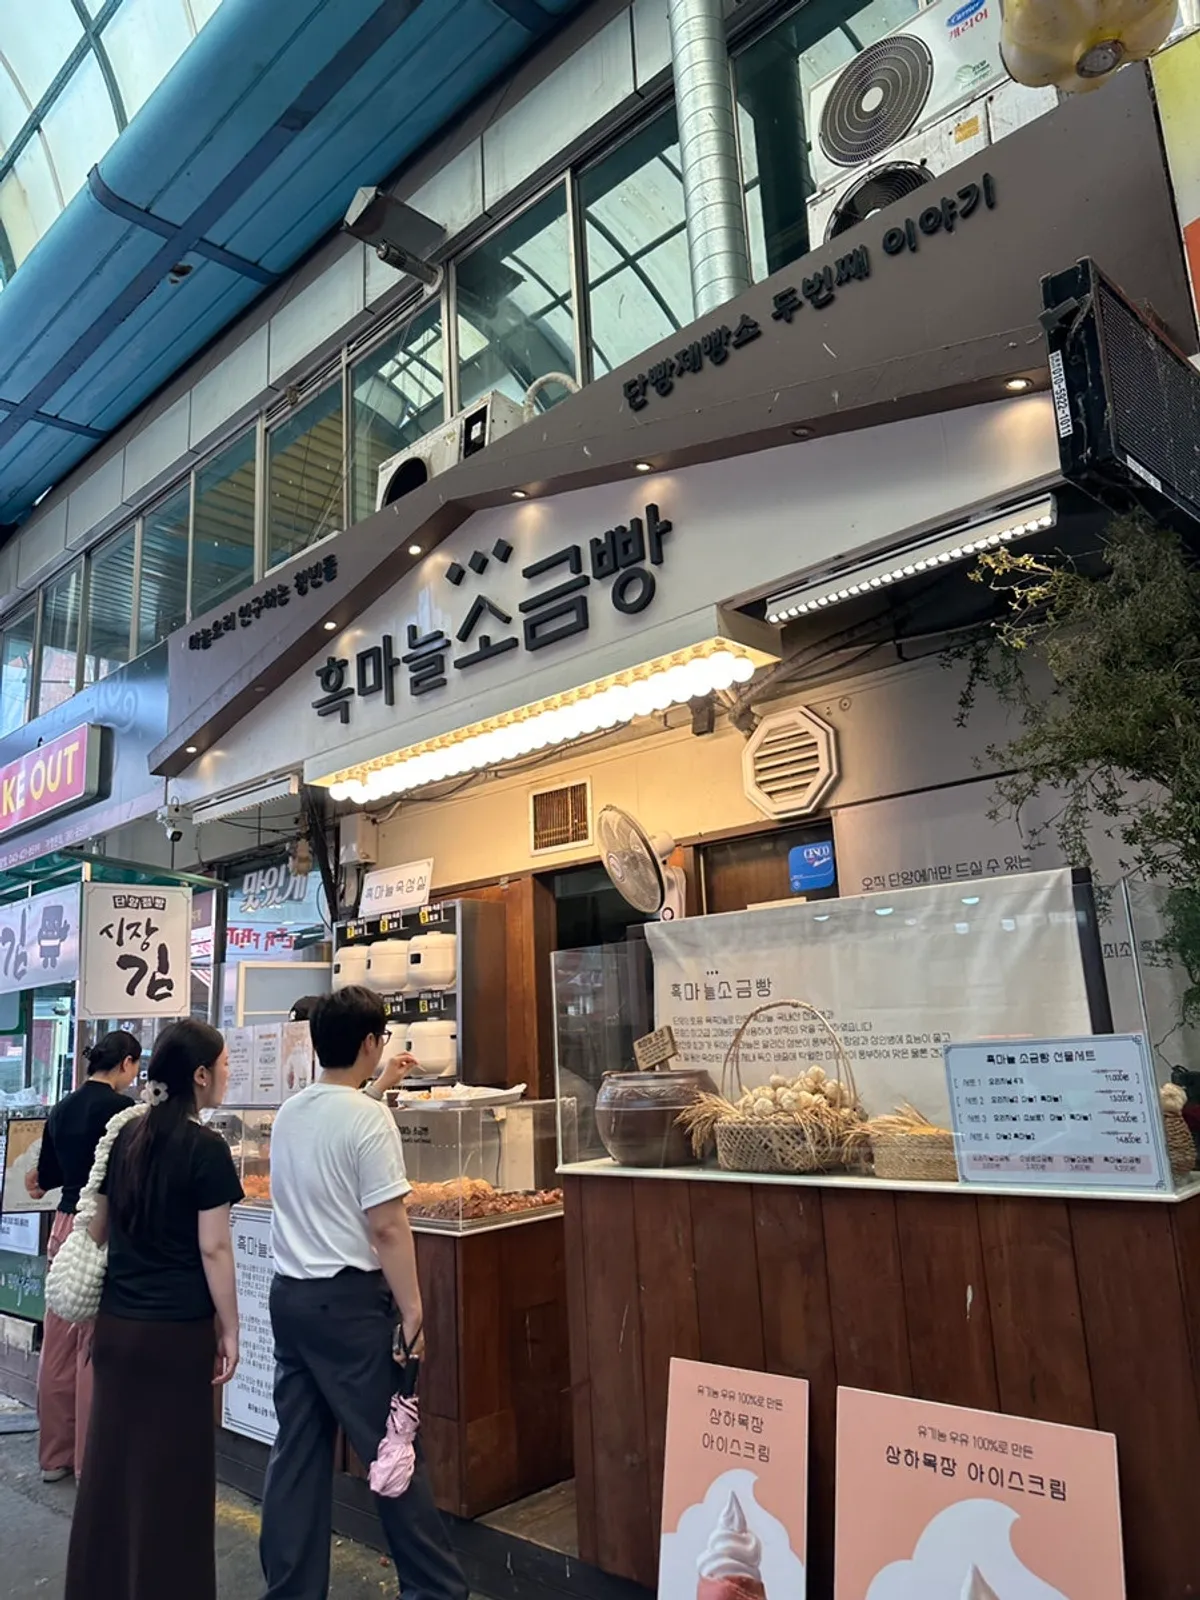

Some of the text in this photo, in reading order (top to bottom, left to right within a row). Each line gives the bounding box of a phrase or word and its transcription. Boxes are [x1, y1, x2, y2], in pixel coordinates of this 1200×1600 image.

[622, 172, 998, 412] 단빵제빵소 두번째 이야기
[29, 741, 80, 801] OUT
[862, 855, 1032, 891] 오직 단양에서만 드실 수 있는
[99, 918, 160, 952] 시장
[117, 943, 174, 1001] 김
[671, 978, 772, 1001] 흑마늘소금빵
[777, 1012, 801, 1021] 국내산
[697, 1385, 783, 1411] 유기농 우유 100%로 만든
[709, 1408, 764, 1434] 상하목장
[702, 1432, 770, 1463] 아이스크림
[918, 1425, 1035, 1460] 유기농 우유 100%로 만든
[886, 1445, 1067, 1501] 상하목장 아이스크림
